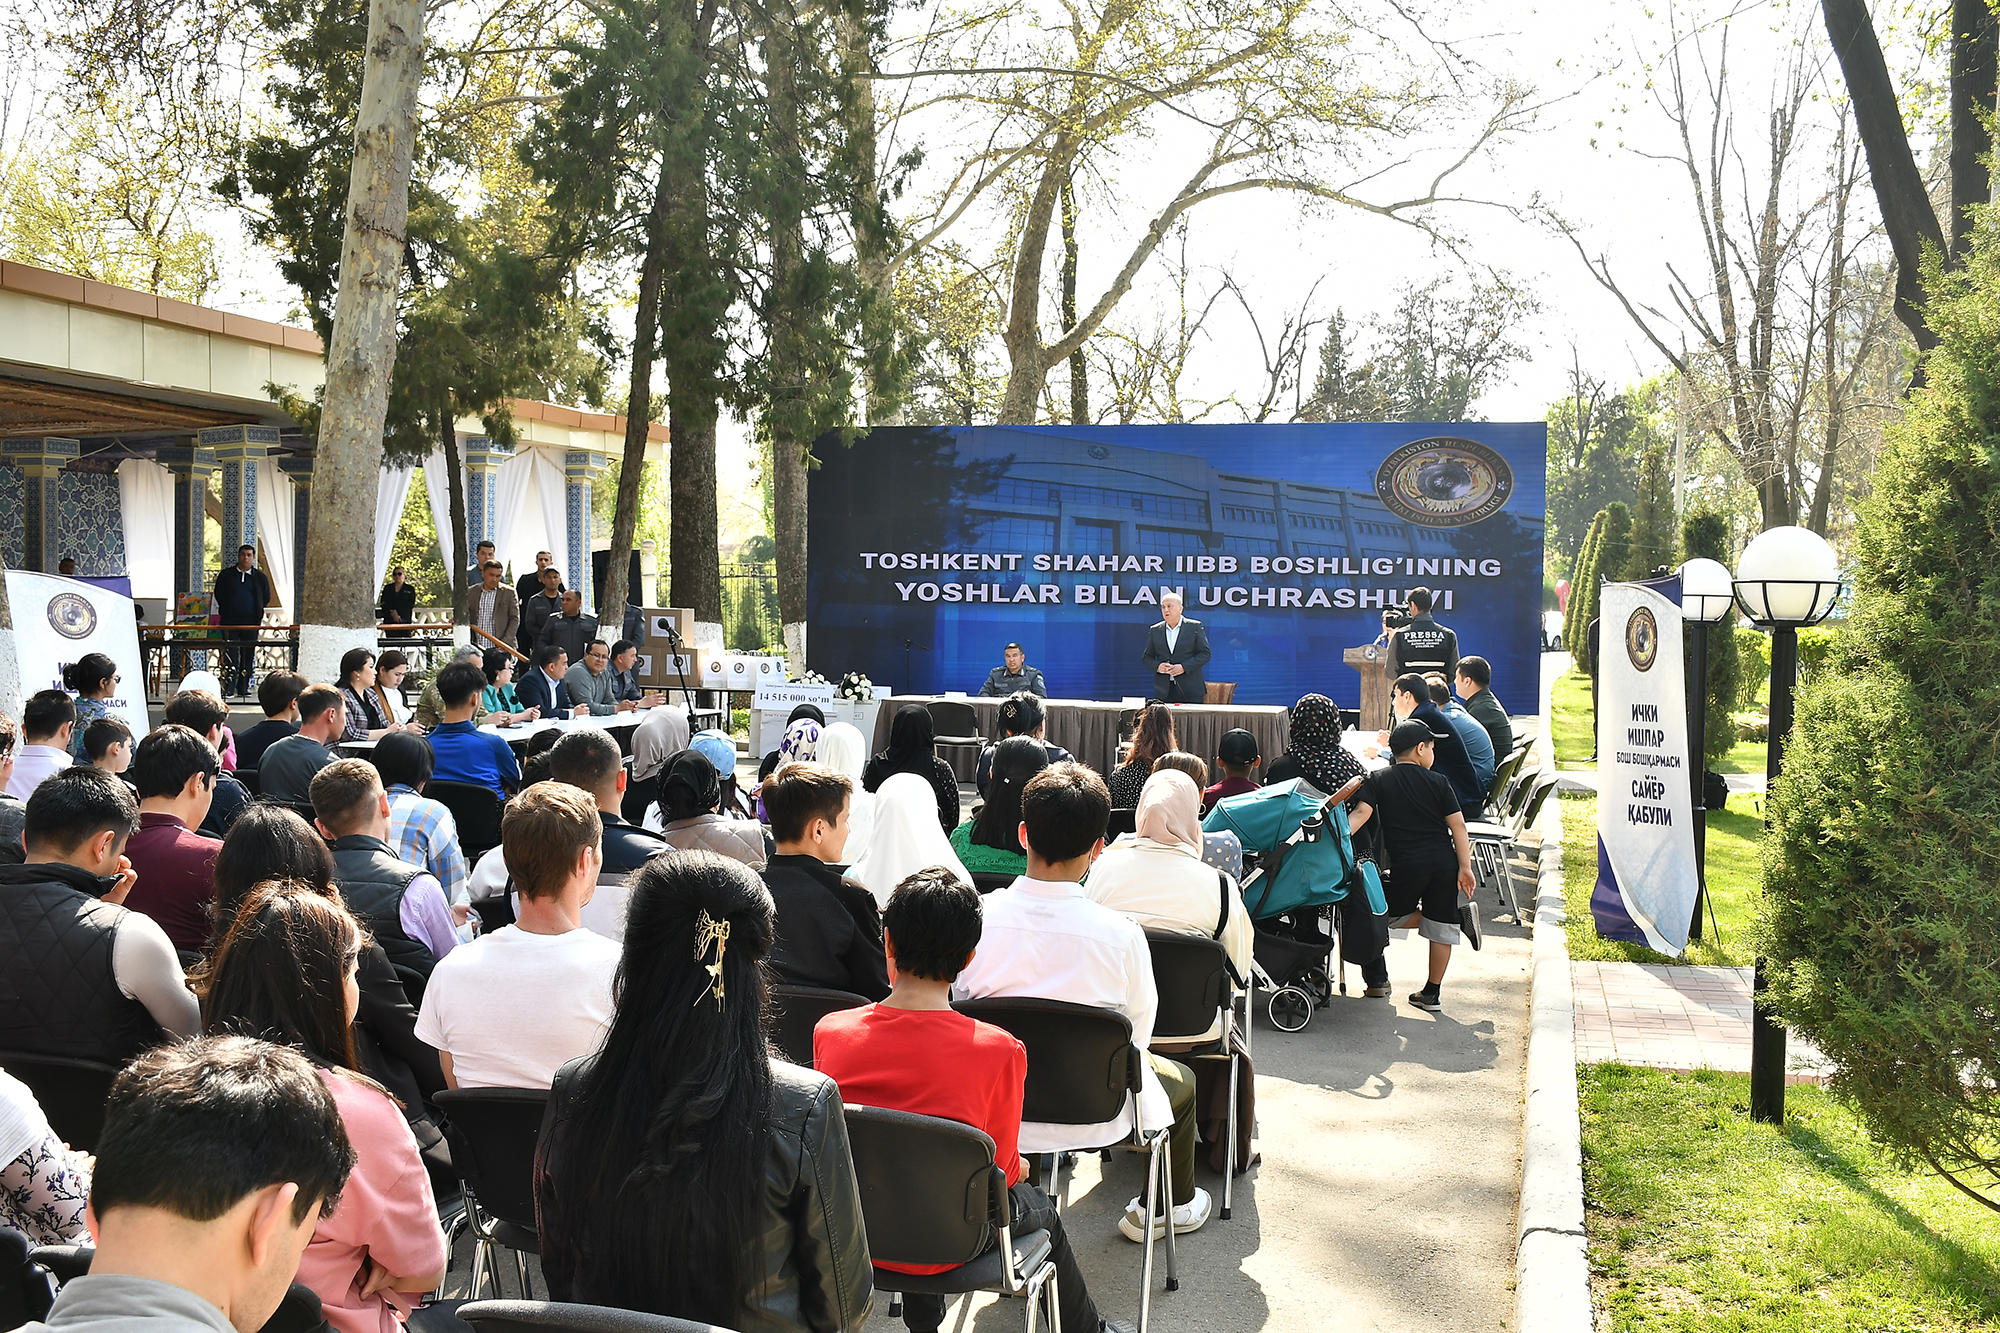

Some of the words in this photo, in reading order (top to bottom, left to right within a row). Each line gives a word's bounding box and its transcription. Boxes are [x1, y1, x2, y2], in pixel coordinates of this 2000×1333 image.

[1454, 495, 1503, 523] VAZIRLIGI
[860, 552, 1022, 571] TOSHKENT
[1033, 554, 1163, 572] SHAHAR
[1176, 555, 1237, 573] IIBB
[1250, 556, 1502, 577] BOSHLIG’INING
[895, 582, 1060, 604] YOSHLAR
[1404, 631, 1445, 640] PRESSA
[760, 692, 769, 701] 14
[771, 692, 788, 702] 515
[790, 694, 806, 702] 000
[1631, 703, 1658, 722] ИЧКИ
[1627, 727, 1664, 748] ИШЛАР
[1616, 751, 1632, 764] БОШ
[1632, 753, 1681, 768] БОШҚАРМАСИ
[1631, 774, 1665, 800] САЙЁР
[1628, 803, 1673, 827] ҚАБУЛИ
